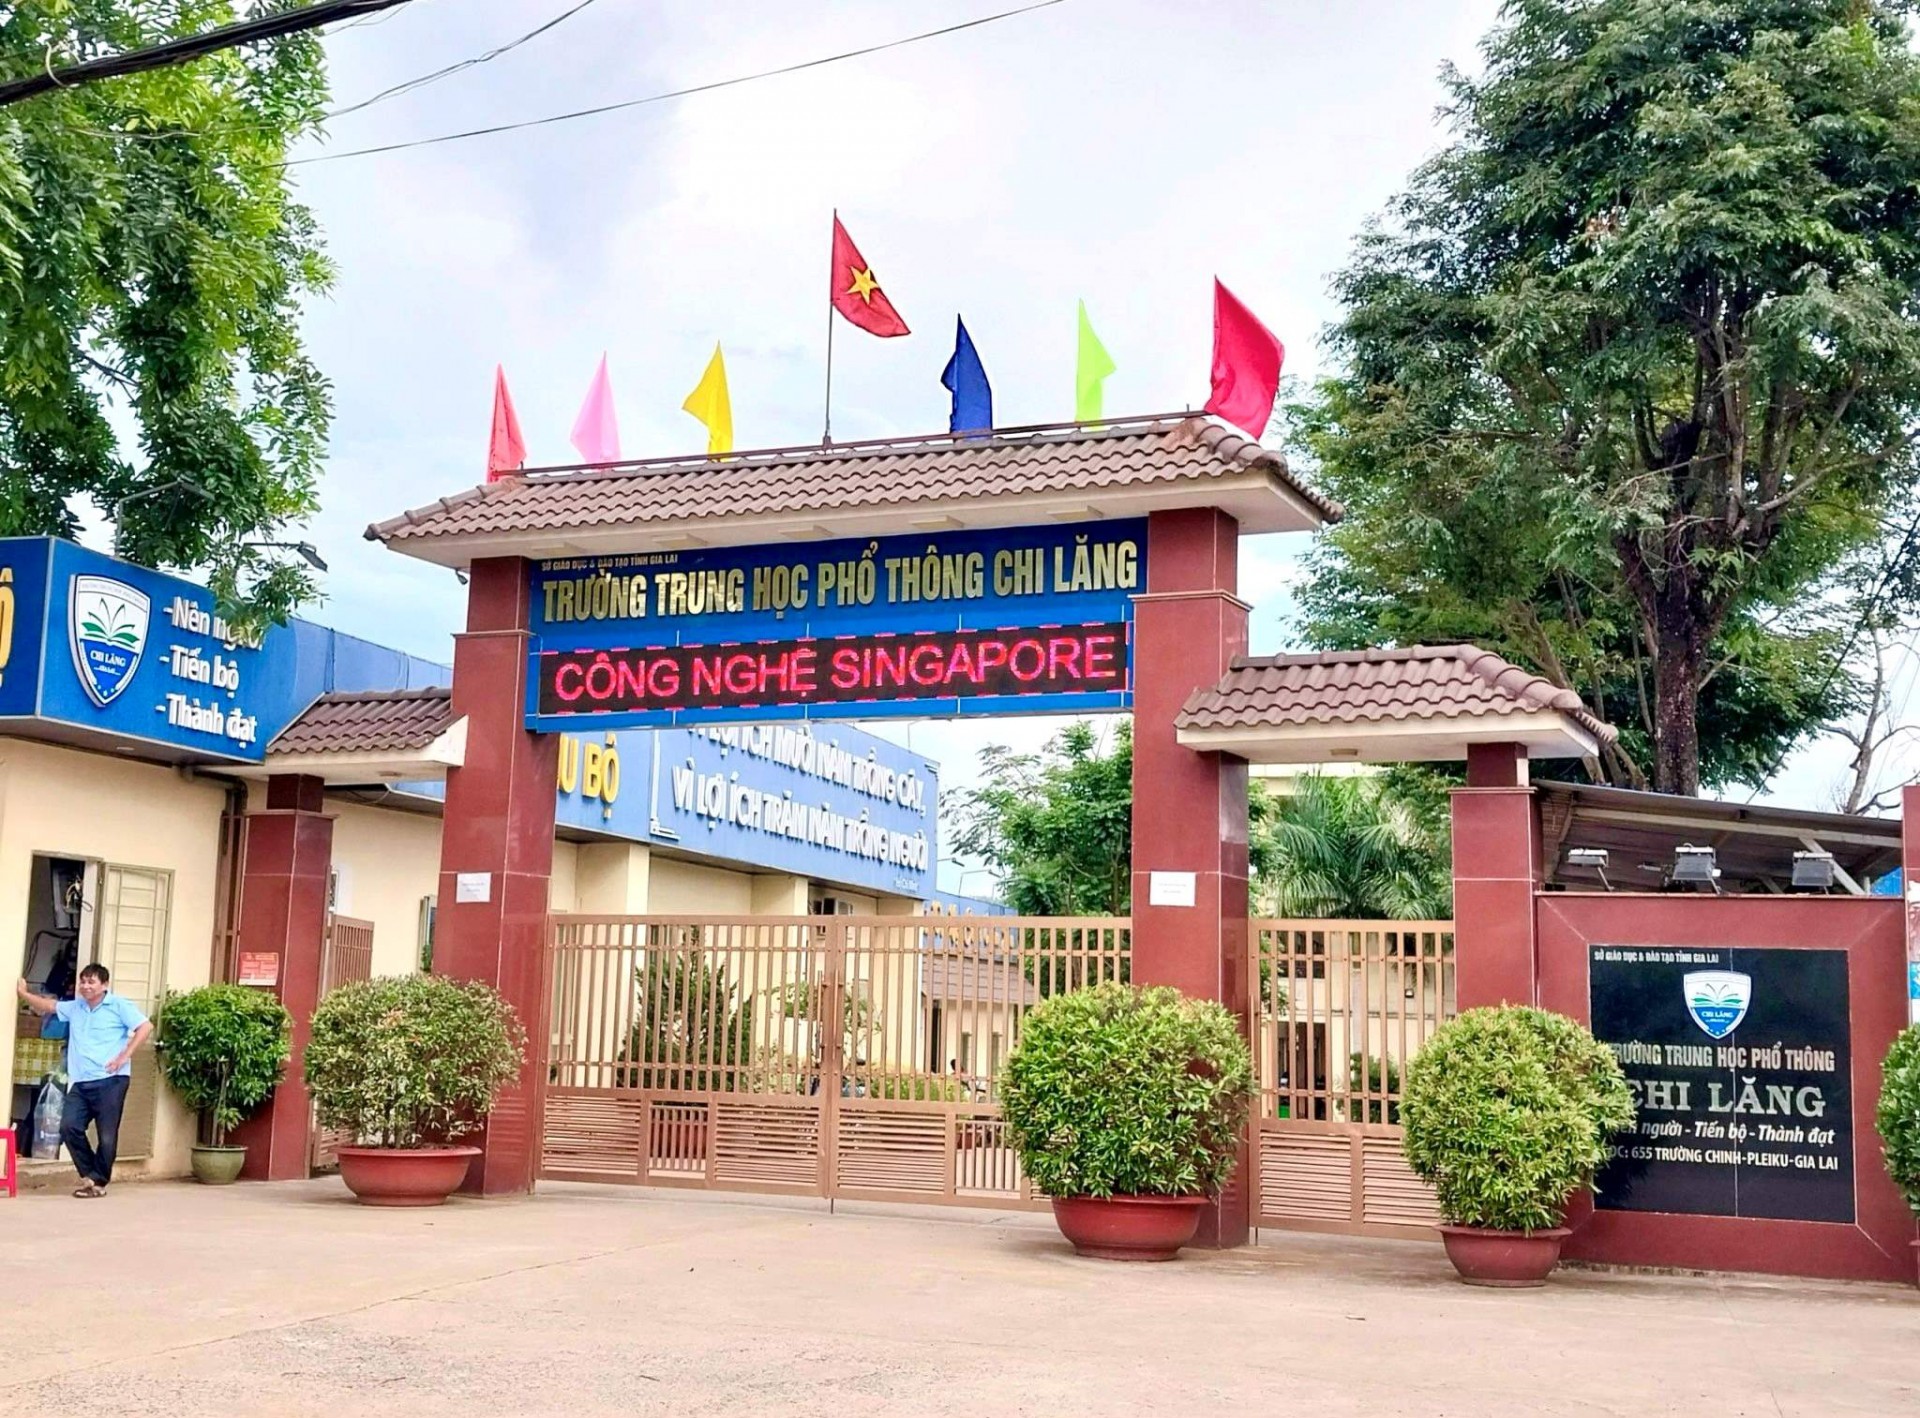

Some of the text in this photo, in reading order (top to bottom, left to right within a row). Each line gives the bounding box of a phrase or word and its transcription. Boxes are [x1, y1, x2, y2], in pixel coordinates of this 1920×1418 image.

[543, 534, 1138, 622] TRƯỜNG TRUNG HỌC PHỔ THÔNG CHI LĂNG
[650, 554, 663, 565] GIA
[665, 553, 678, 564] LAI
[213, 655, 240, 698] bộ
[555, 635, 1116, 701] CÔNG NGHỆ SINGAPORE
[226, 707, 257, 748] đạt
[582, 730, 620, 819] BỘ
[817, 738, 852, 785] NĂM
[853, 746, 896, 802] TRỒNG
[672, 757, 929, 871] VÌ LỢI ÍCH TRĂM NĂM TRỒNG NGƯỜI
[1693, 953, 1706, 964] GIA
[1707, 953, 1719, 964] LAI
[1664, 1045, 1713, 1067] TRUNG
[1717, 1046, 1747, 1072] HỌC
[1751, 1041, 1782, 1069] PHỔ
[1784, 1046, 1835, 1072] THÔNG
[1707, 1076, 1826, 1117] LĂNG
[1641, 1119, 1682, 1140] người
[1695, 1120, 1725, 1139] Tiến
[1728, 1122, 1748, 1143] bộ
[1758, 1124, 1805, 1143] Thành
[1807, 1126, 1836, 1147] đạt
[1631, 1146, 1653, 1160] 655
[1655, 1145, 1702, 1162] TRƯỜNG
[1818, 1156, 1838, 1170] LAI
